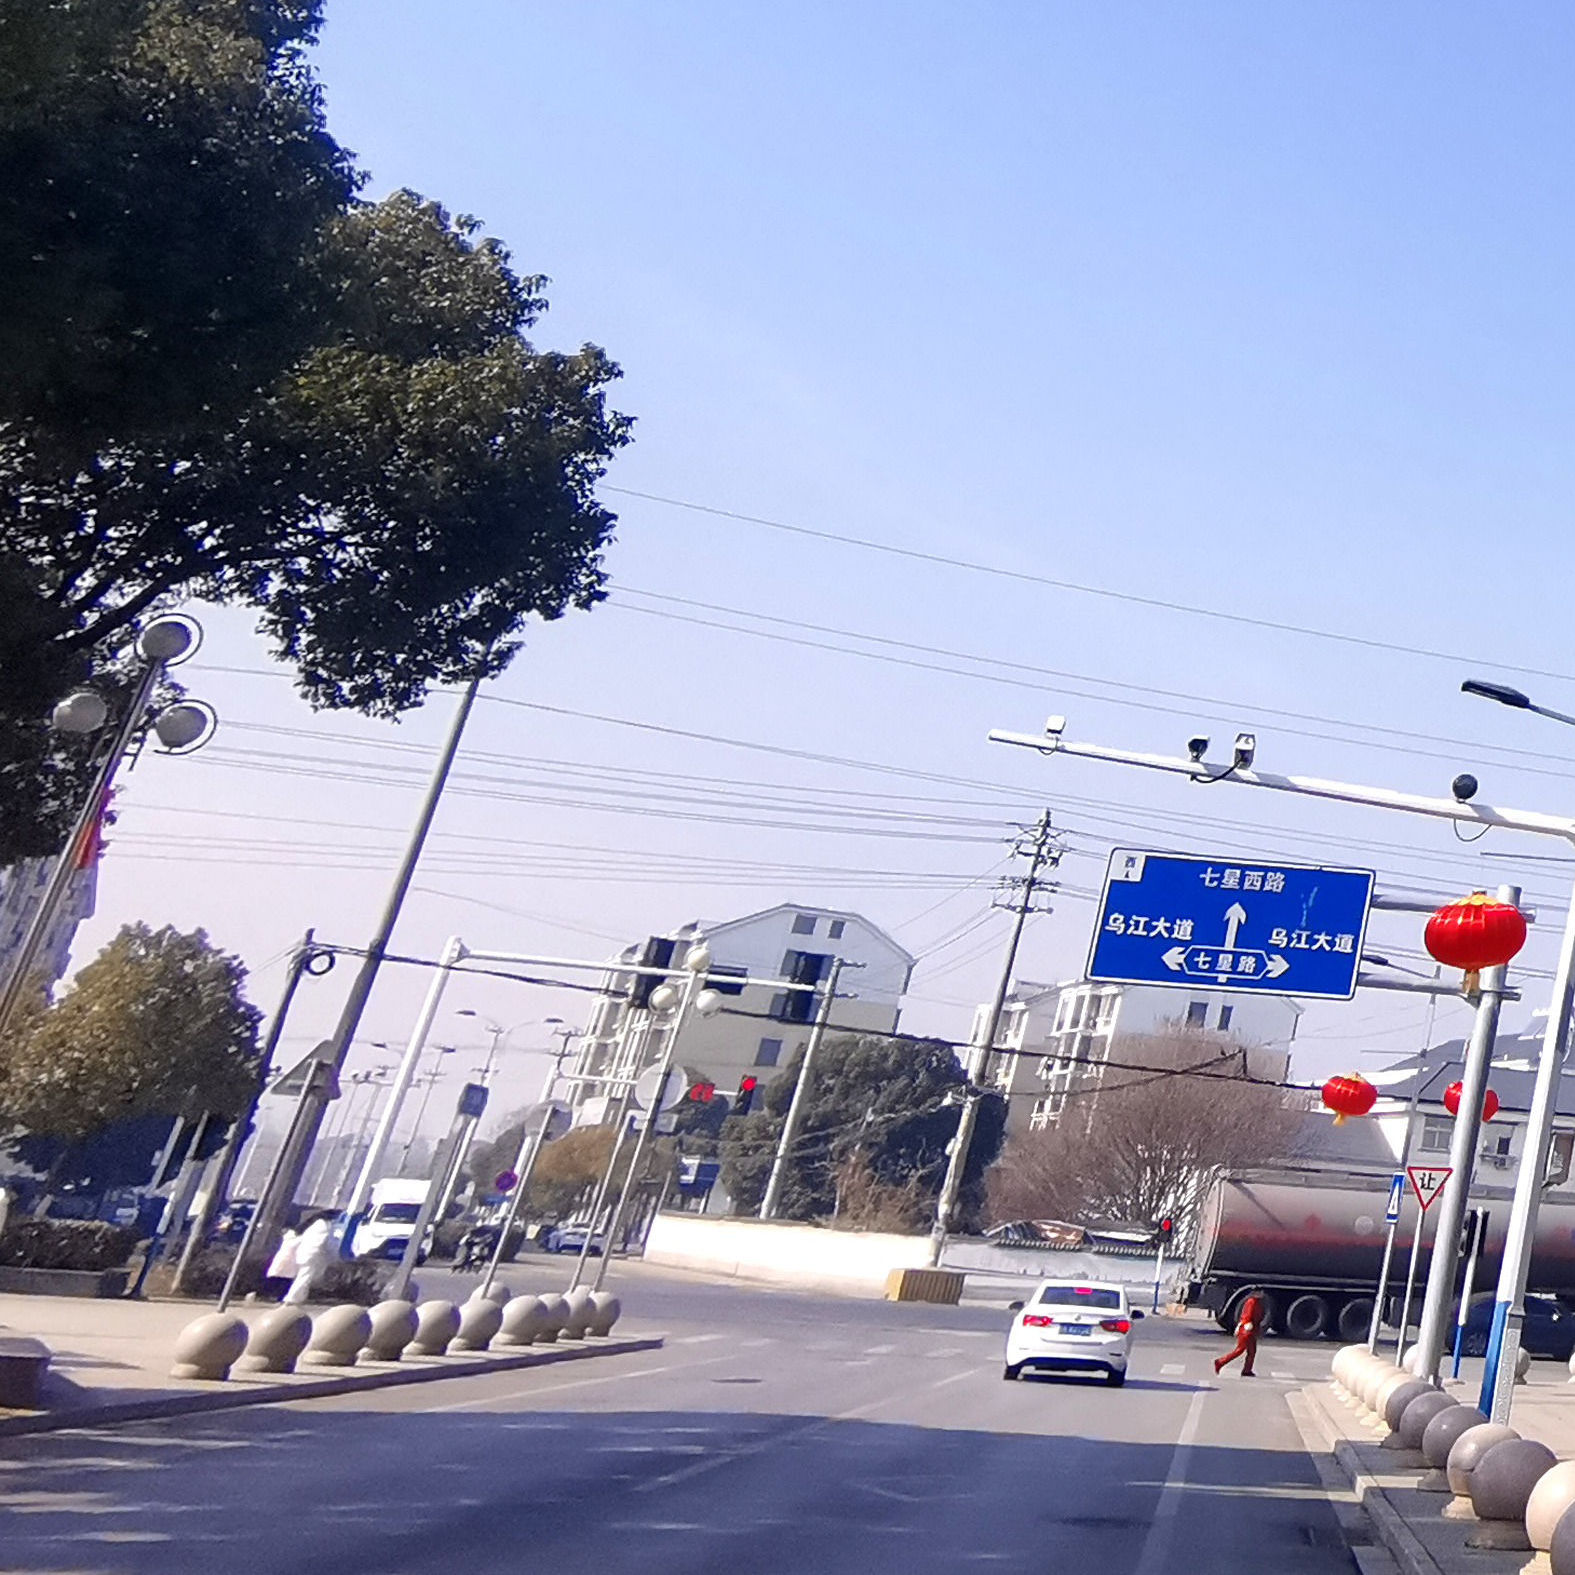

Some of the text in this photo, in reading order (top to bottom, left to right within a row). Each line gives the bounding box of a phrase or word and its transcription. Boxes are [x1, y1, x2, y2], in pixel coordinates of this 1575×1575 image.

[1199, 866, 1286, 893] 七星西路
[1104, 912, 1195, 941] 乌江大道
[1267, 927, 1356, 954] 乌江大道
[1193, 952, 1258, 974] 七星路
[1419, 1172, 1436, 1190] 让
